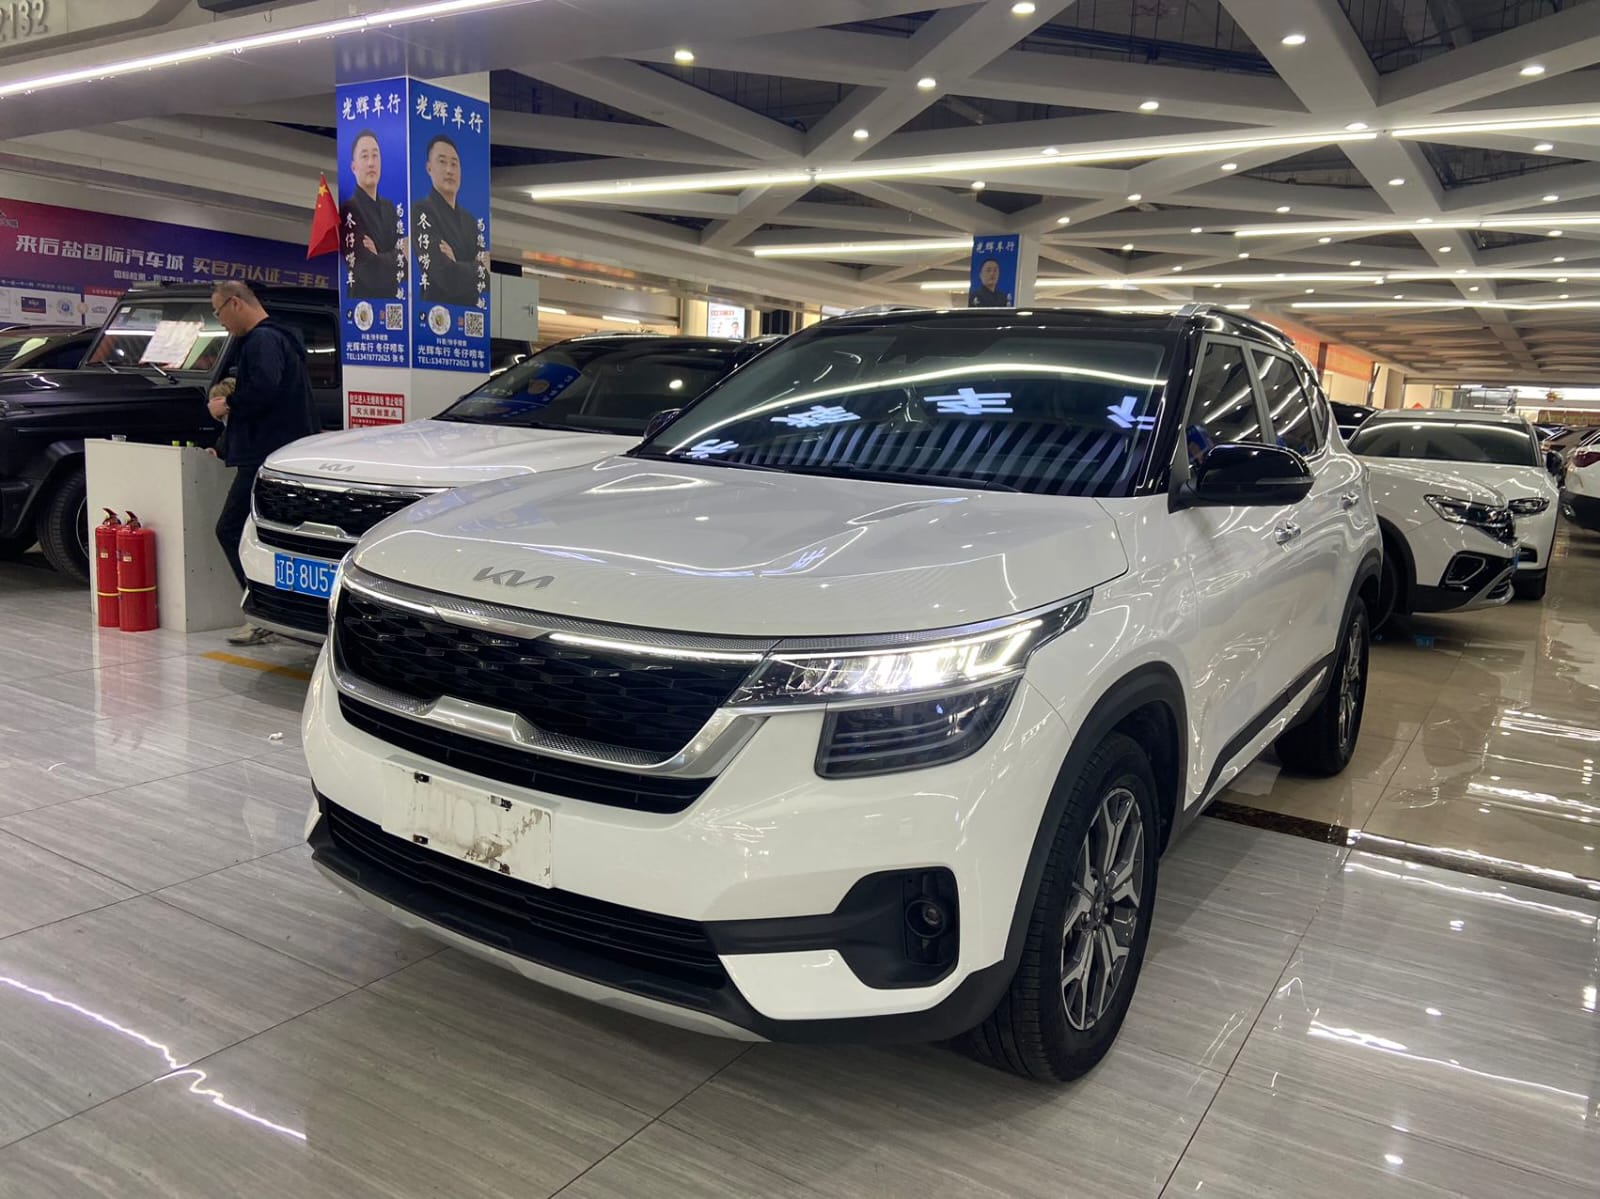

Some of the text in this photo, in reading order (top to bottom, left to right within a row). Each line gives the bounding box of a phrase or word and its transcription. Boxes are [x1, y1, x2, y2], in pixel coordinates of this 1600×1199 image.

[342, 93, 401, 120] 光辉车行
[415, 94, 484, 134] 光辉车行
